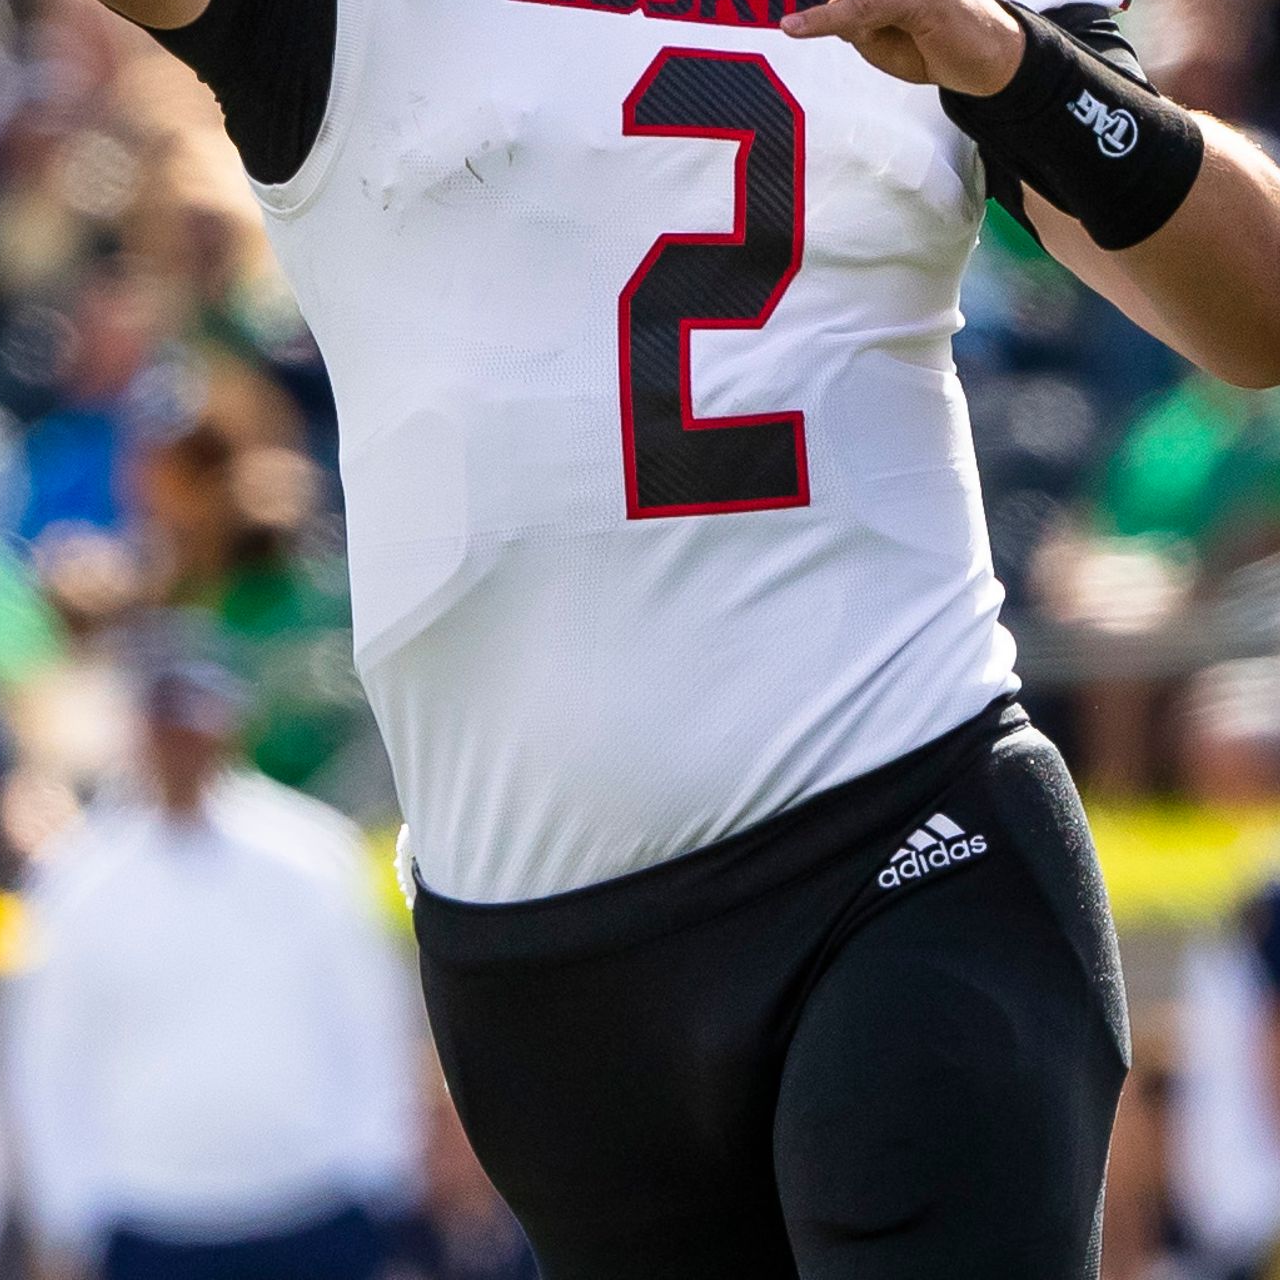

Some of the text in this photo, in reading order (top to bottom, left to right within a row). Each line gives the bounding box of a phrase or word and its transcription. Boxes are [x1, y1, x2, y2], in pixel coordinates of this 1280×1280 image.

[1072, 89, 1136, 155] TAG
[618, 46, 810, 520] 2
[878, 835, 988, 888] adidas
